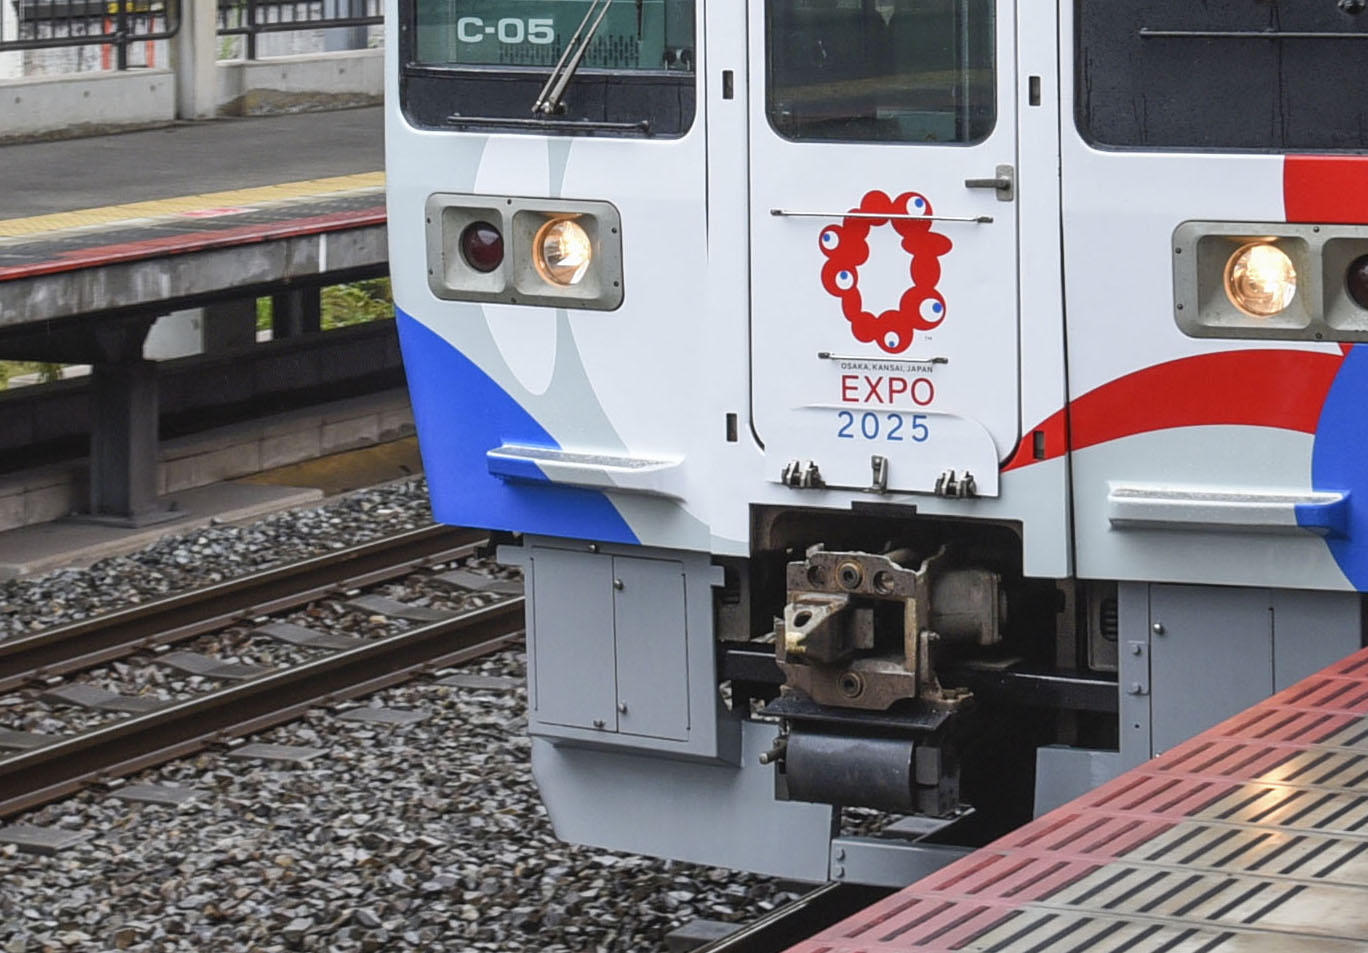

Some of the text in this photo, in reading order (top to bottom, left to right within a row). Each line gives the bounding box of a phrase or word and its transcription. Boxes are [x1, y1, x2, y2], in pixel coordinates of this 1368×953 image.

[457, 16, 555, 44] C-05
[841, 362, 933, 373] OSAKA, KANSAI, JAPAN
[841, 374, 935, 407] EXPO
[837, 410, 930, 443] 2025
